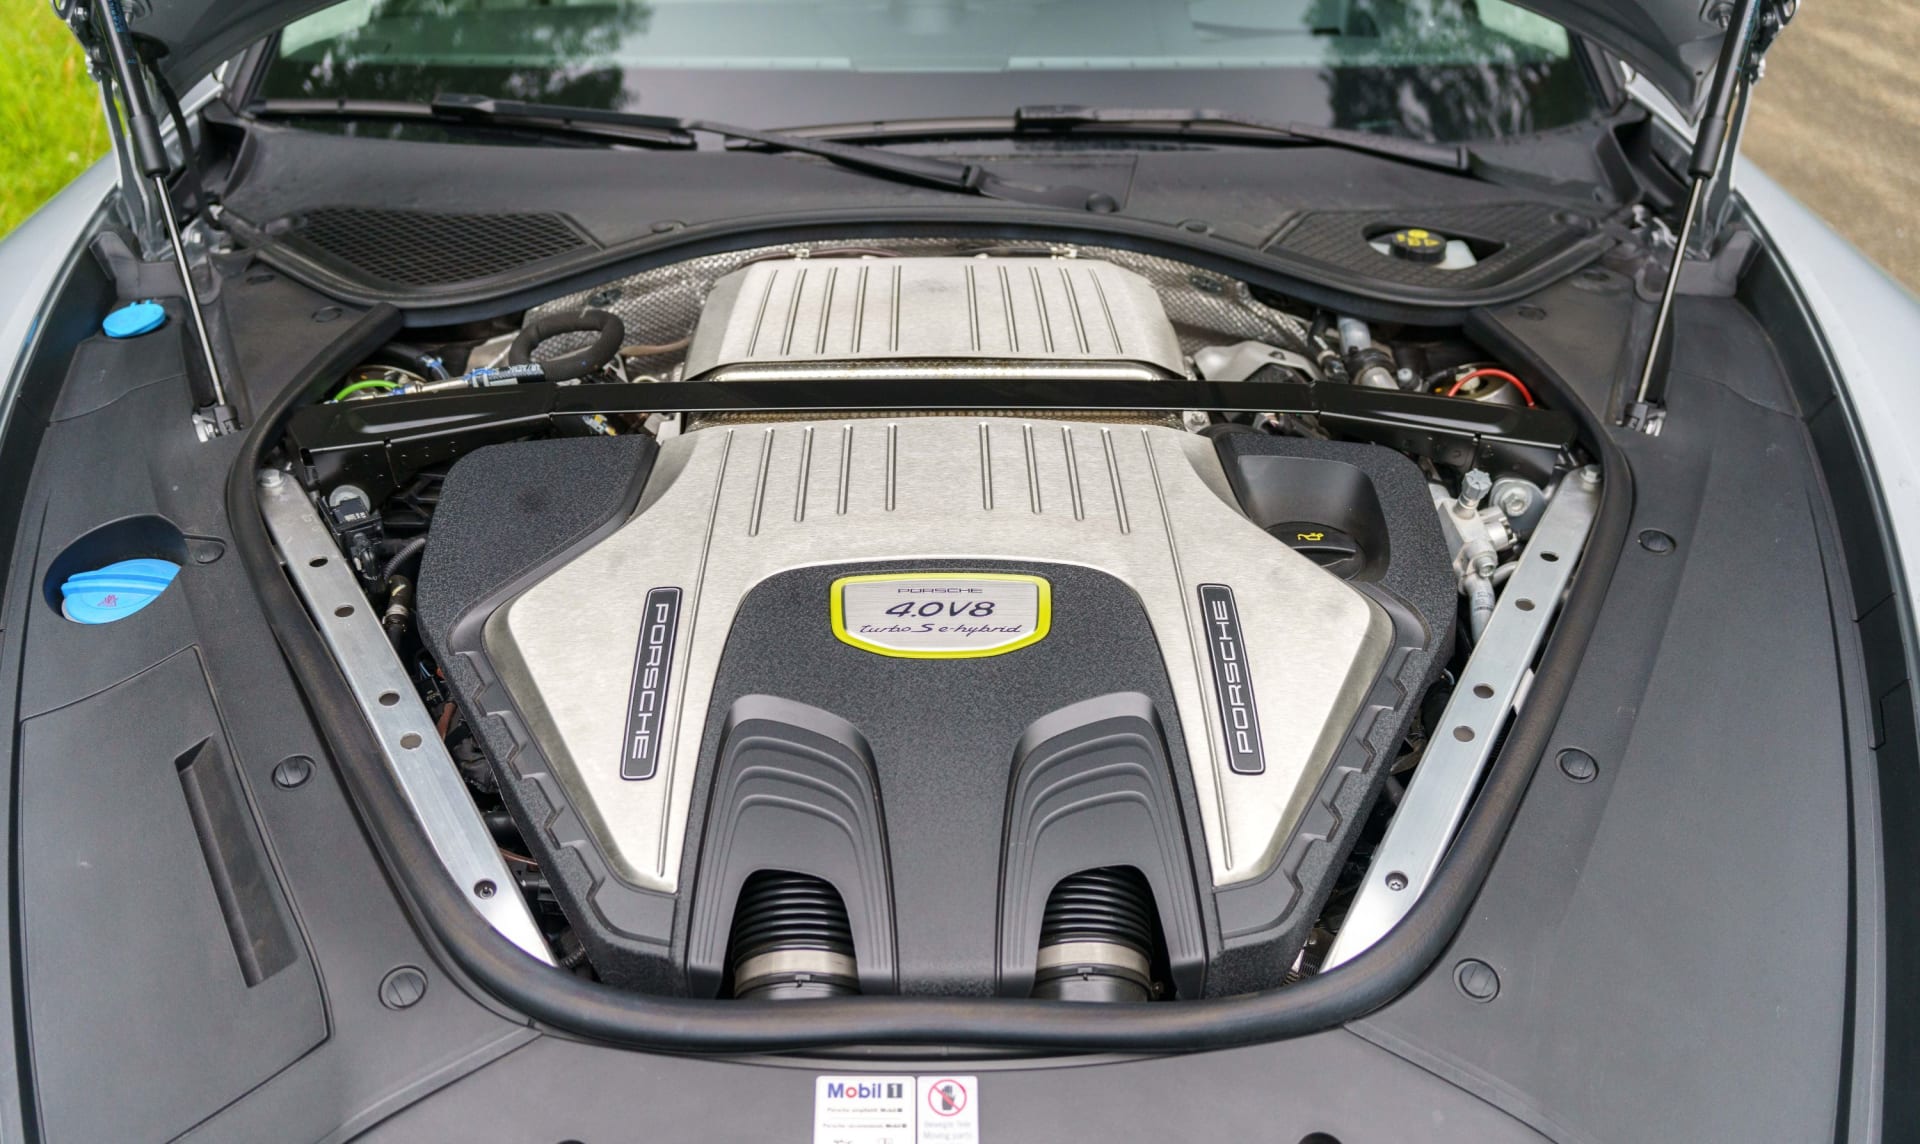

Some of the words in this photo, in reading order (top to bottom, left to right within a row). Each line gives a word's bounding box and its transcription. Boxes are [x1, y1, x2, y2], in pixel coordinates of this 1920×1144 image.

[911, 623, 935, 633] S
[938, 624, 1023, 637] e-hybrid
[632, 603, 670, 759] PORSCHE
[1212, 600, 1253, 754] PORSCHE
[828, 1083, 882, 1099] Mobil
[886, 1083, 903, 1098] 1
